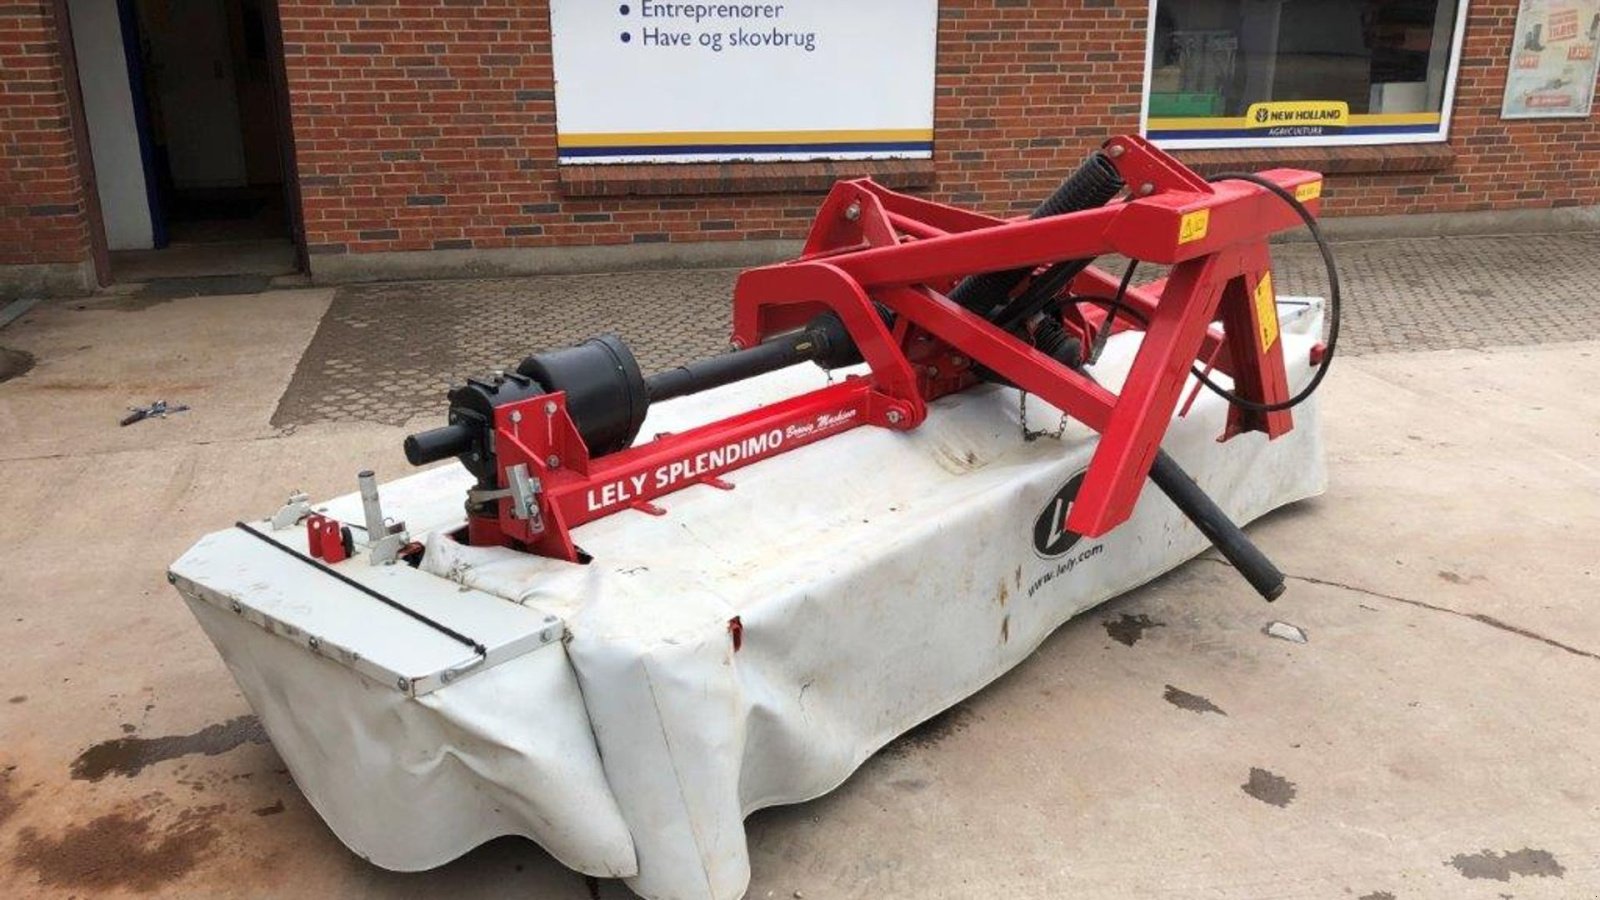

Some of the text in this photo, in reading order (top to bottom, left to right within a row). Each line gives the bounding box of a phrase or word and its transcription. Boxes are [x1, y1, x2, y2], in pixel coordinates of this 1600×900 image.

[641, 0, 784, 23] Entreprenører
[642, 27, 816, 52] Have og skovbrug
[1270, 109, 1341, 121] NEW HOLLAND
[1268, 126, 1323, 136] AGRICULTURE
[587, 429, 784, 511] LELY SPLENDIMO
[1027, 543, 1104, 598] www.lely.com
